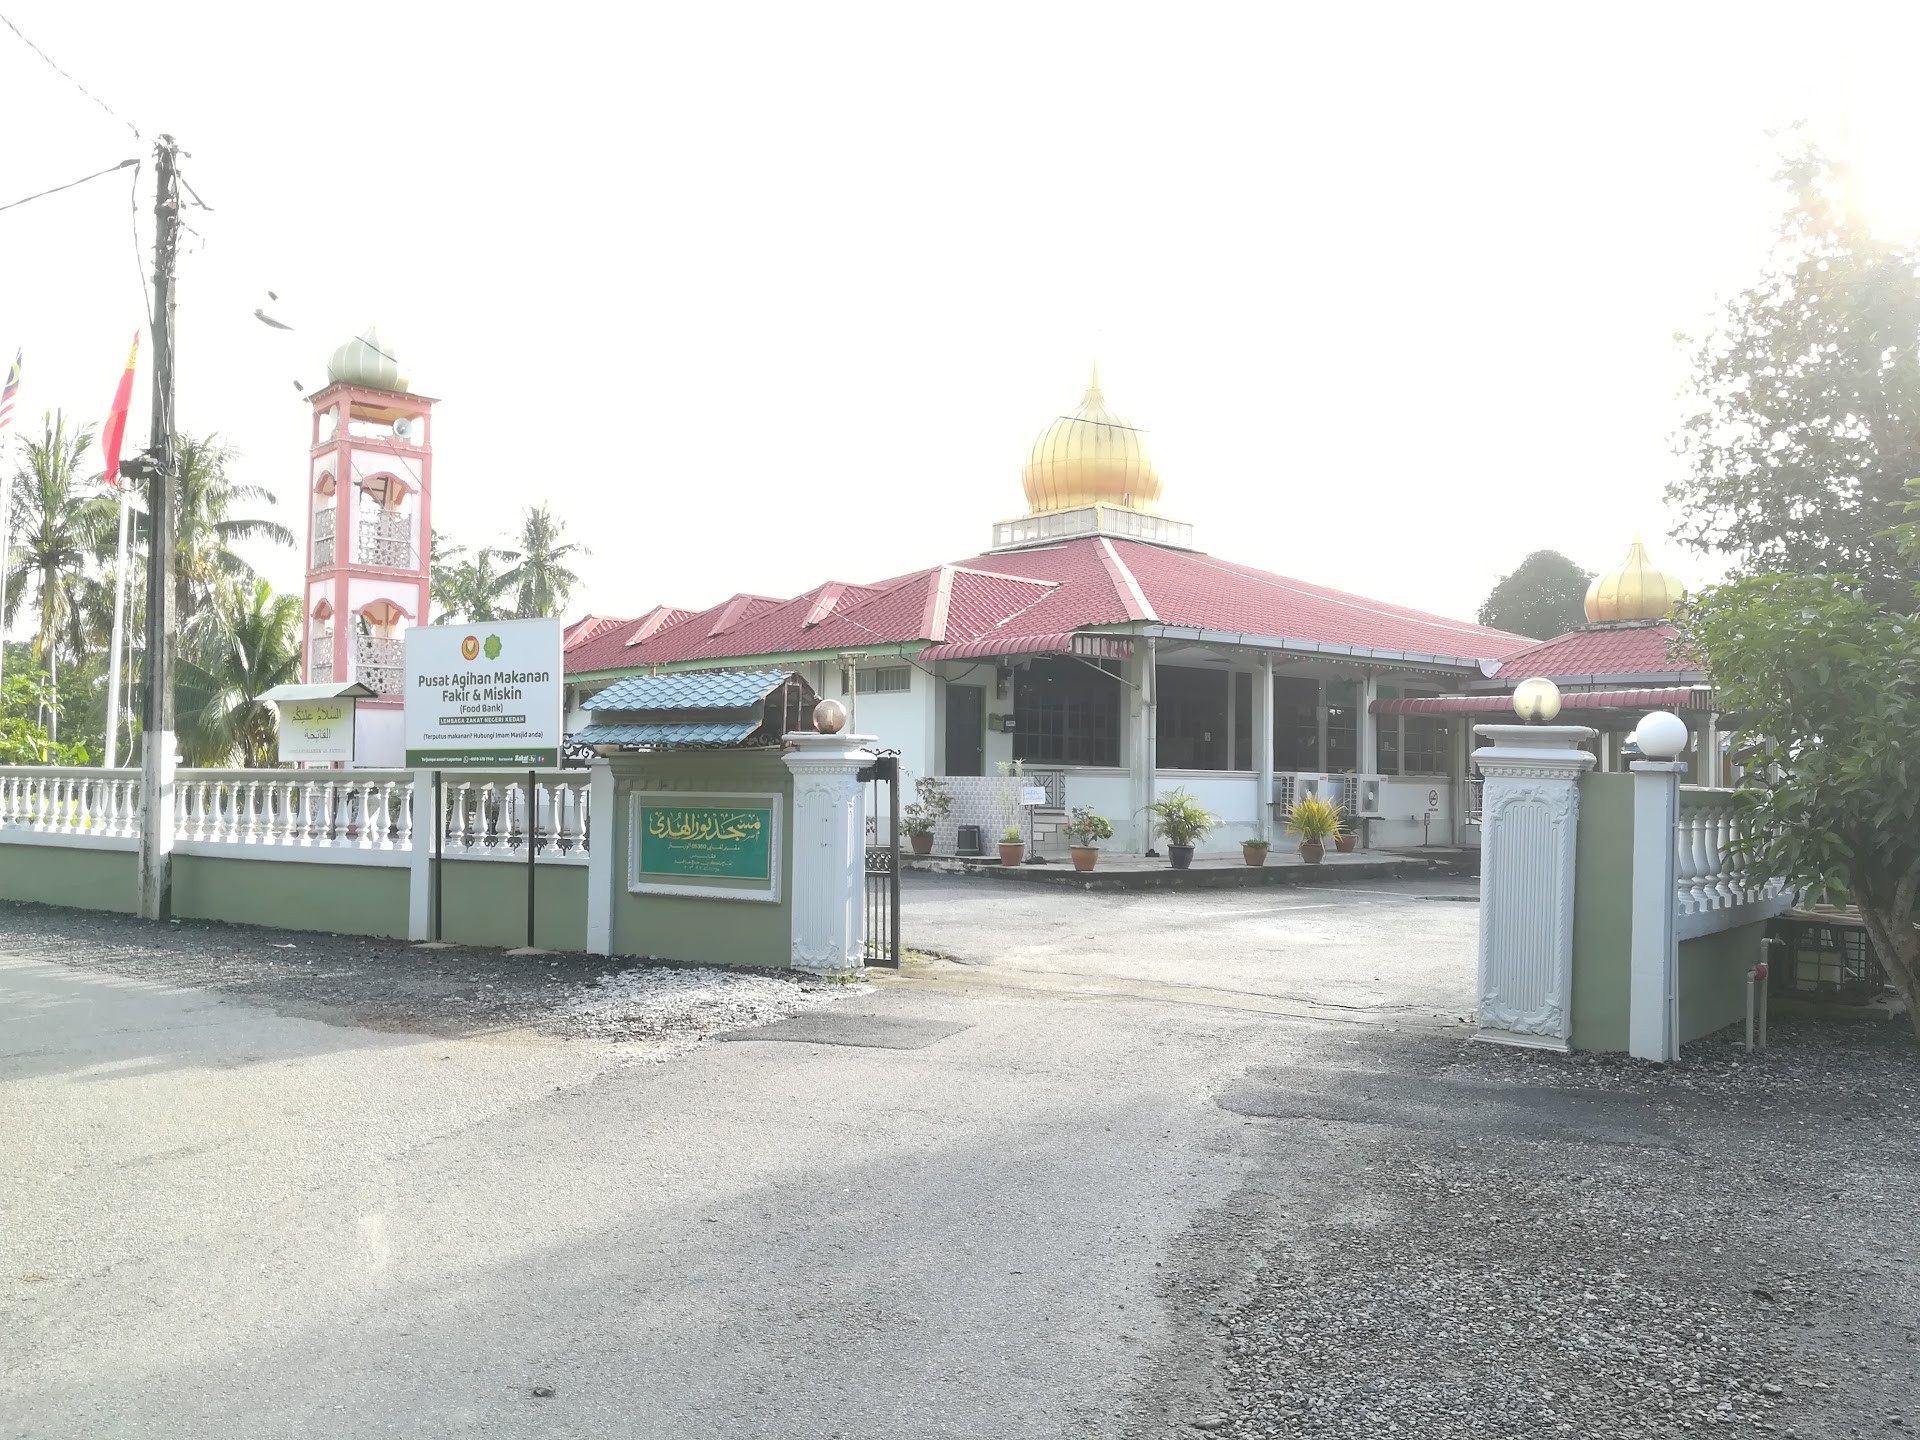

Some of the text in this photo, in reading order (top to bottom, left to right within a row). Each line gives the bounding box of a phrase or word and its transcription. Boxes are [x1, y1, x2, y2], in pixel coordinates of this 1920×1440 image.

[418, 670, 549, 688] Pusat Agihan Makanan
[442, 686, 522, 702] Fakir & Miskin
[460, 703, 504, 714] (Food Bank)
[440, 716, 465, 724] LEMBAGA
[465, 716, 484, 724] ZAKAT
[505, 715, 525, 723] KEDAH
[423, 733, 447, 741] (Terputus
[473, 732, 495, 740] Hubungi
[510, 731, 528, 740] Masjid
